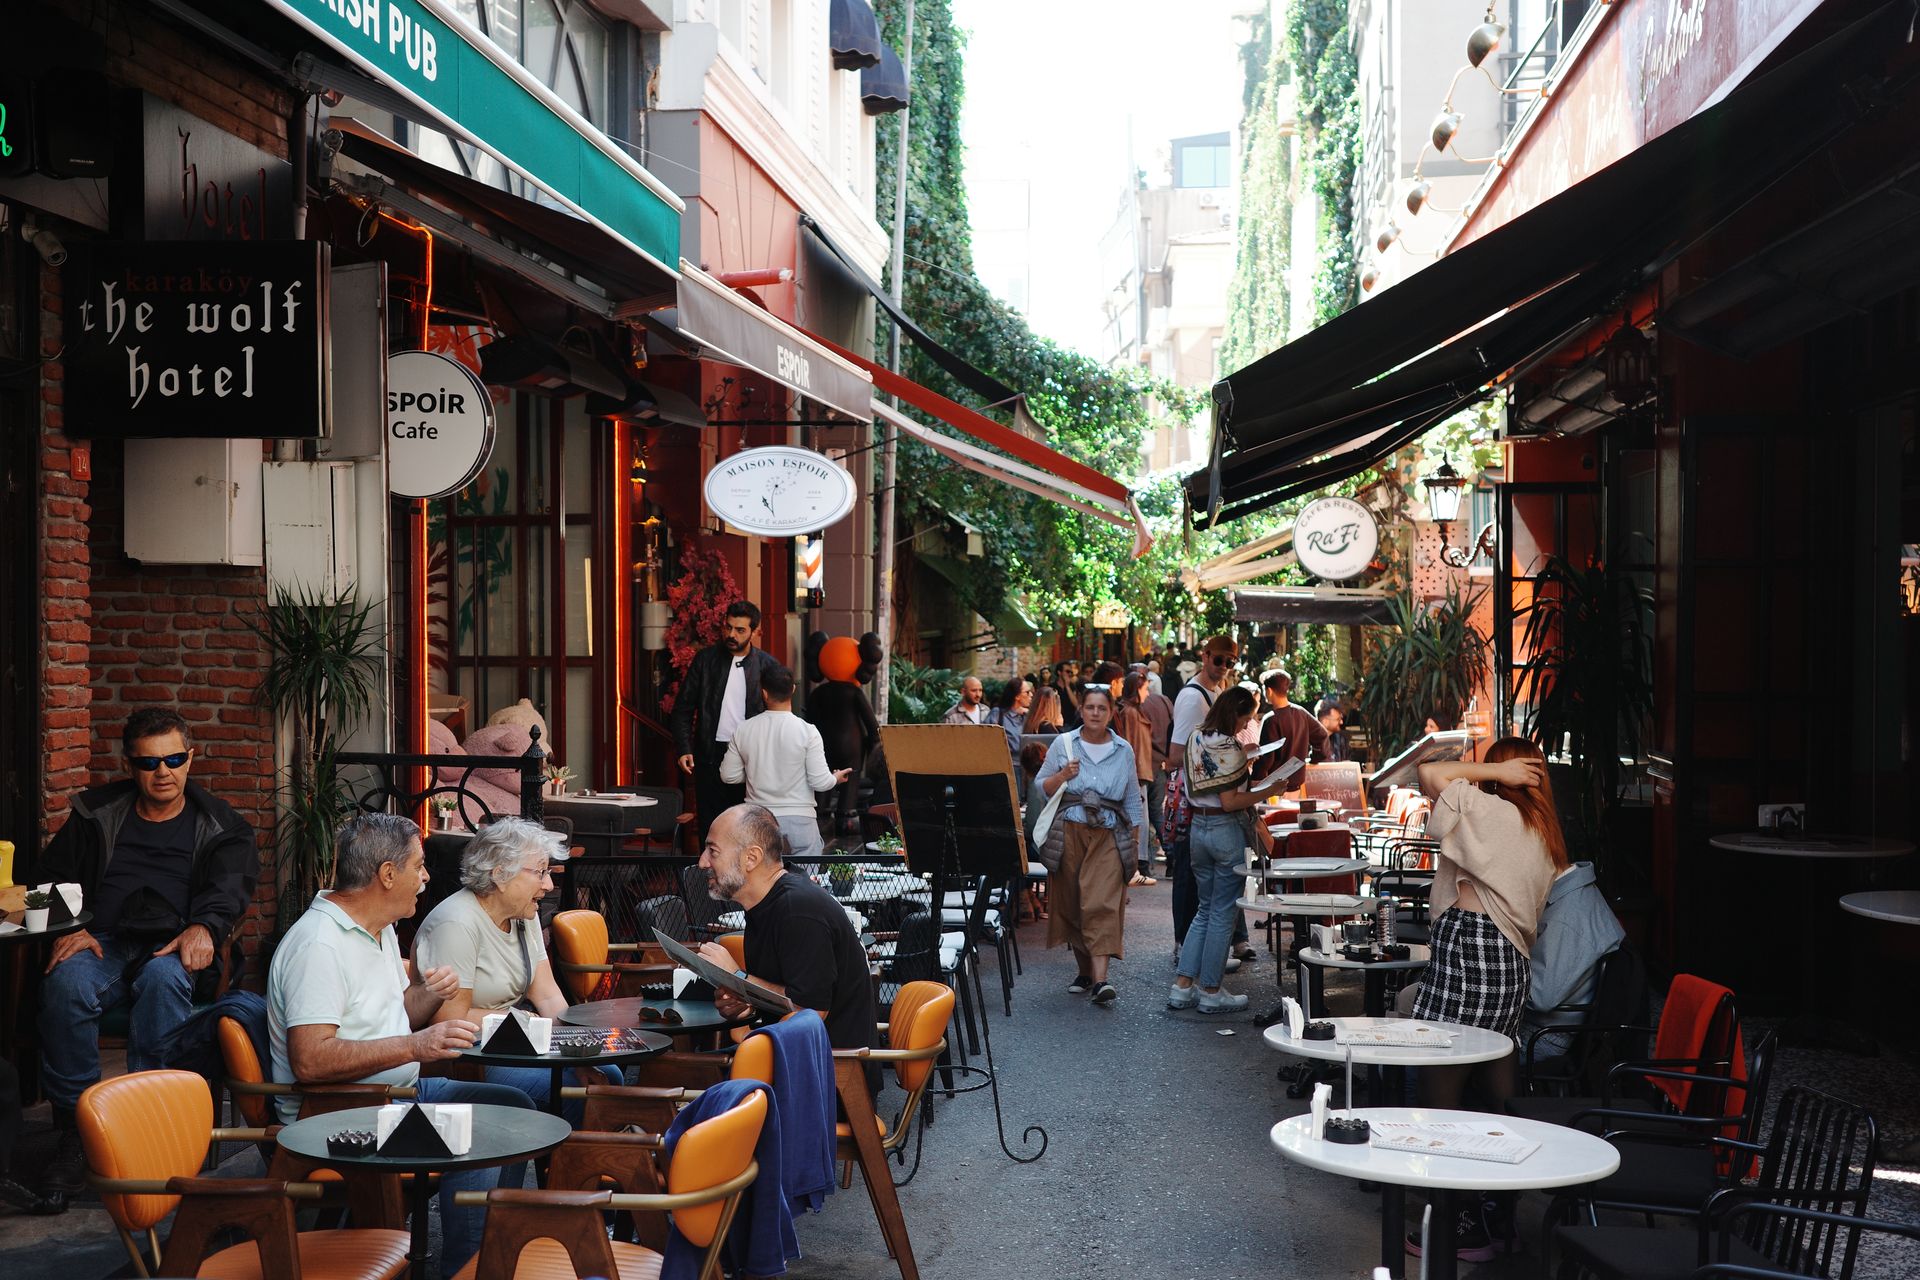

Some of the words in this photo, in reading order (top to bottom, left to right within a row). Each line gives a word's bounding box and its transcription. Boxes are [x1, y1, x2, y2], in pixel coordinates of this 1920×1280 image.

[389, 2, 437, 81] PUB
[178, 125, 266, 240] hotel
[125, 267, 254, 297] karaköy
[79, 280, 154, 344] the
[186, 280, 302, 334] wolf
[125, 345, 255, 410] hotel
[392, 421, 438, 439] Cafe
[77, 456, 87, 472] 14
[726, 458, 775, 478] MAISON
[783, 458, 829, 480] ESPOIR
[1334, 500, 1365, 519] RESTO
